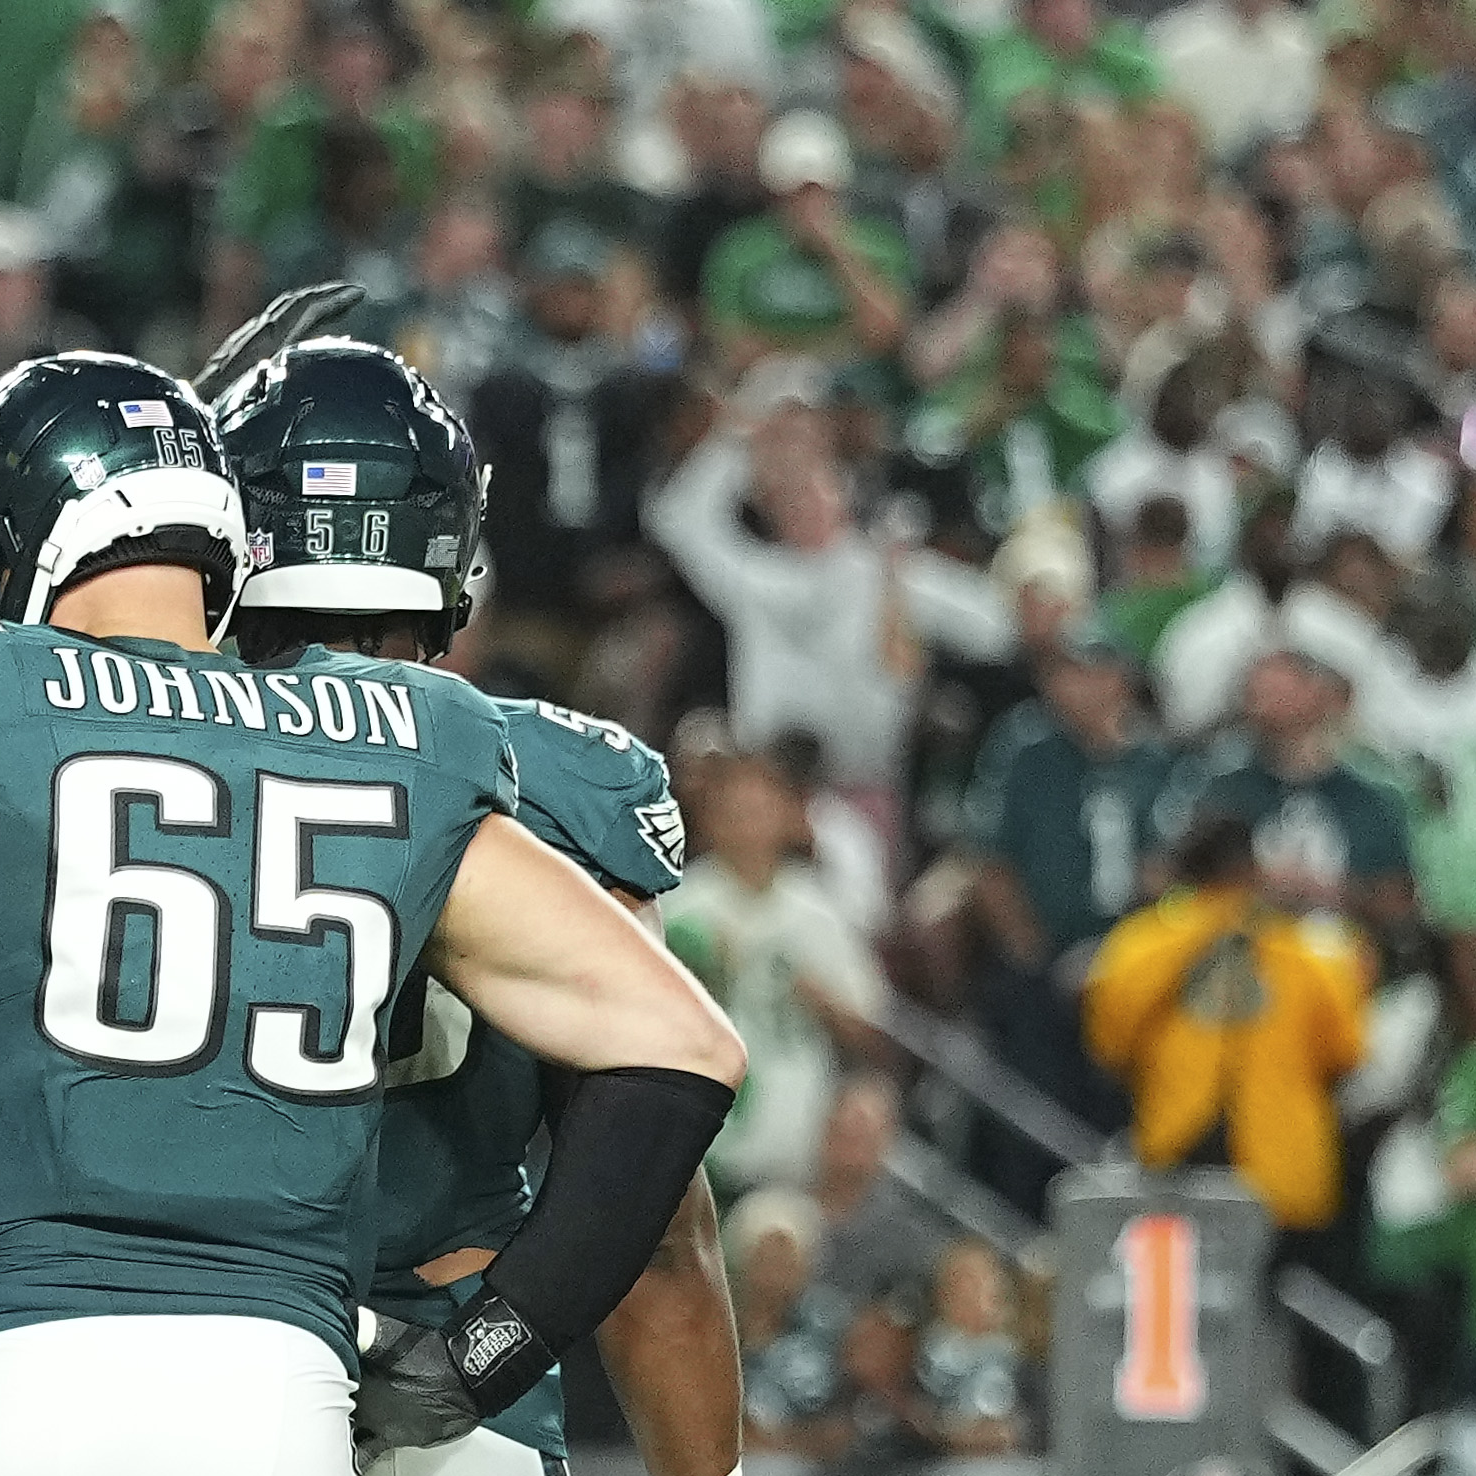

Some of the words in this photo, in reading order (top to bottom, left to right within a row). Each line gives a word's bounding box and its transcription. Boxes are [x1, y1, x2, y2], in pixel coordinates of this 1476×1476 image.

[153, 427, 205, 471] 65
[45, 647, 420, 750] JOHNSON
[37, 752, 411, 1104] 65
[1113, 1214, 1209, 1421] 1
